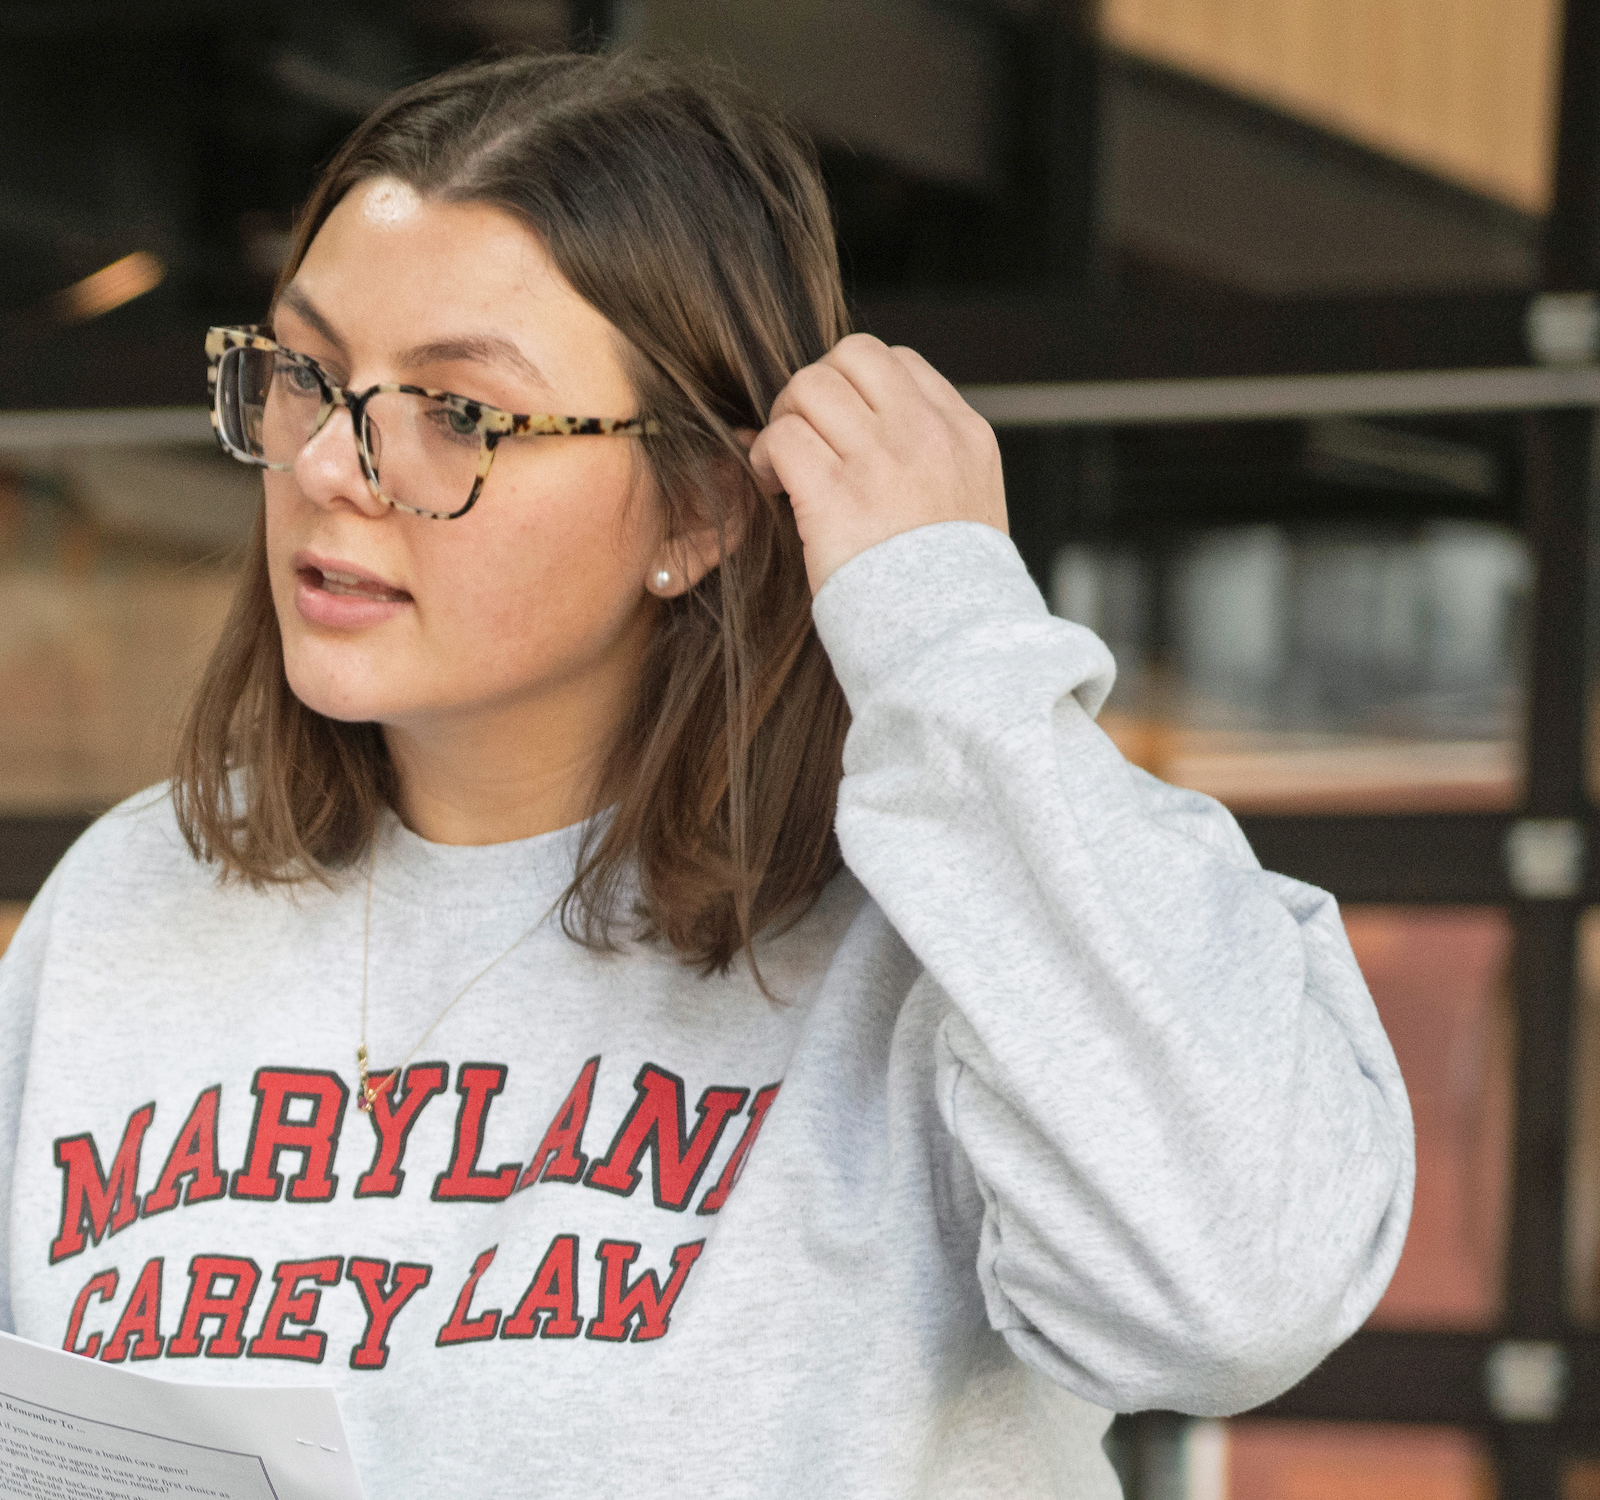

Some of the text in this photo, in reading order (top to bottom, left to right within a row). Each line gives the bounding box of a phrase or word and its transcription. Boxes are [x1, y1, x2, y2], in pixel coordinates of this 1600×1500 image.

[62, 1233, 707, 1370] CAREY LAW
[6, 1402, 56, 1425] Remember
[6, 1447, 29, 1458] agent
[59, 1464, 97, 1477] available
[101, 1474, 128, 1485] when
[130, 1481, 169, 1493] needed?
[9, 1439, 28, 1450] two
[29, 1446, 67, 1463] back-up
[69, 1459, 99, 1470] agents
[113, 1470, 134, 1478] case
[137, 1475, 158, 1484] your
[161, 1479, 182, 1489] first
[185, 1485, 216, 1495] choice
[12, 1426, 29, 1436] you
[30, 1432, 54, 1444] want
[67, 1442, 93, 1453] name
[102, 1450, 133, 1463] health
[134, 1460, 155, 1468] care
[158, 1465, 188, 1475] agent?
[5, 1477, 22, 1487] you
[25, 1483, 42, 1492] also
[43, 1489, 66, 1499] want
[16, 1466, 44, 1478] agents
[64, 1479, 103, 1495] back-up
[106, 1491, 130, 1500] agent
[32, 1477, 60, 1490] decide
[66, 1488, 104, 1500] whether
